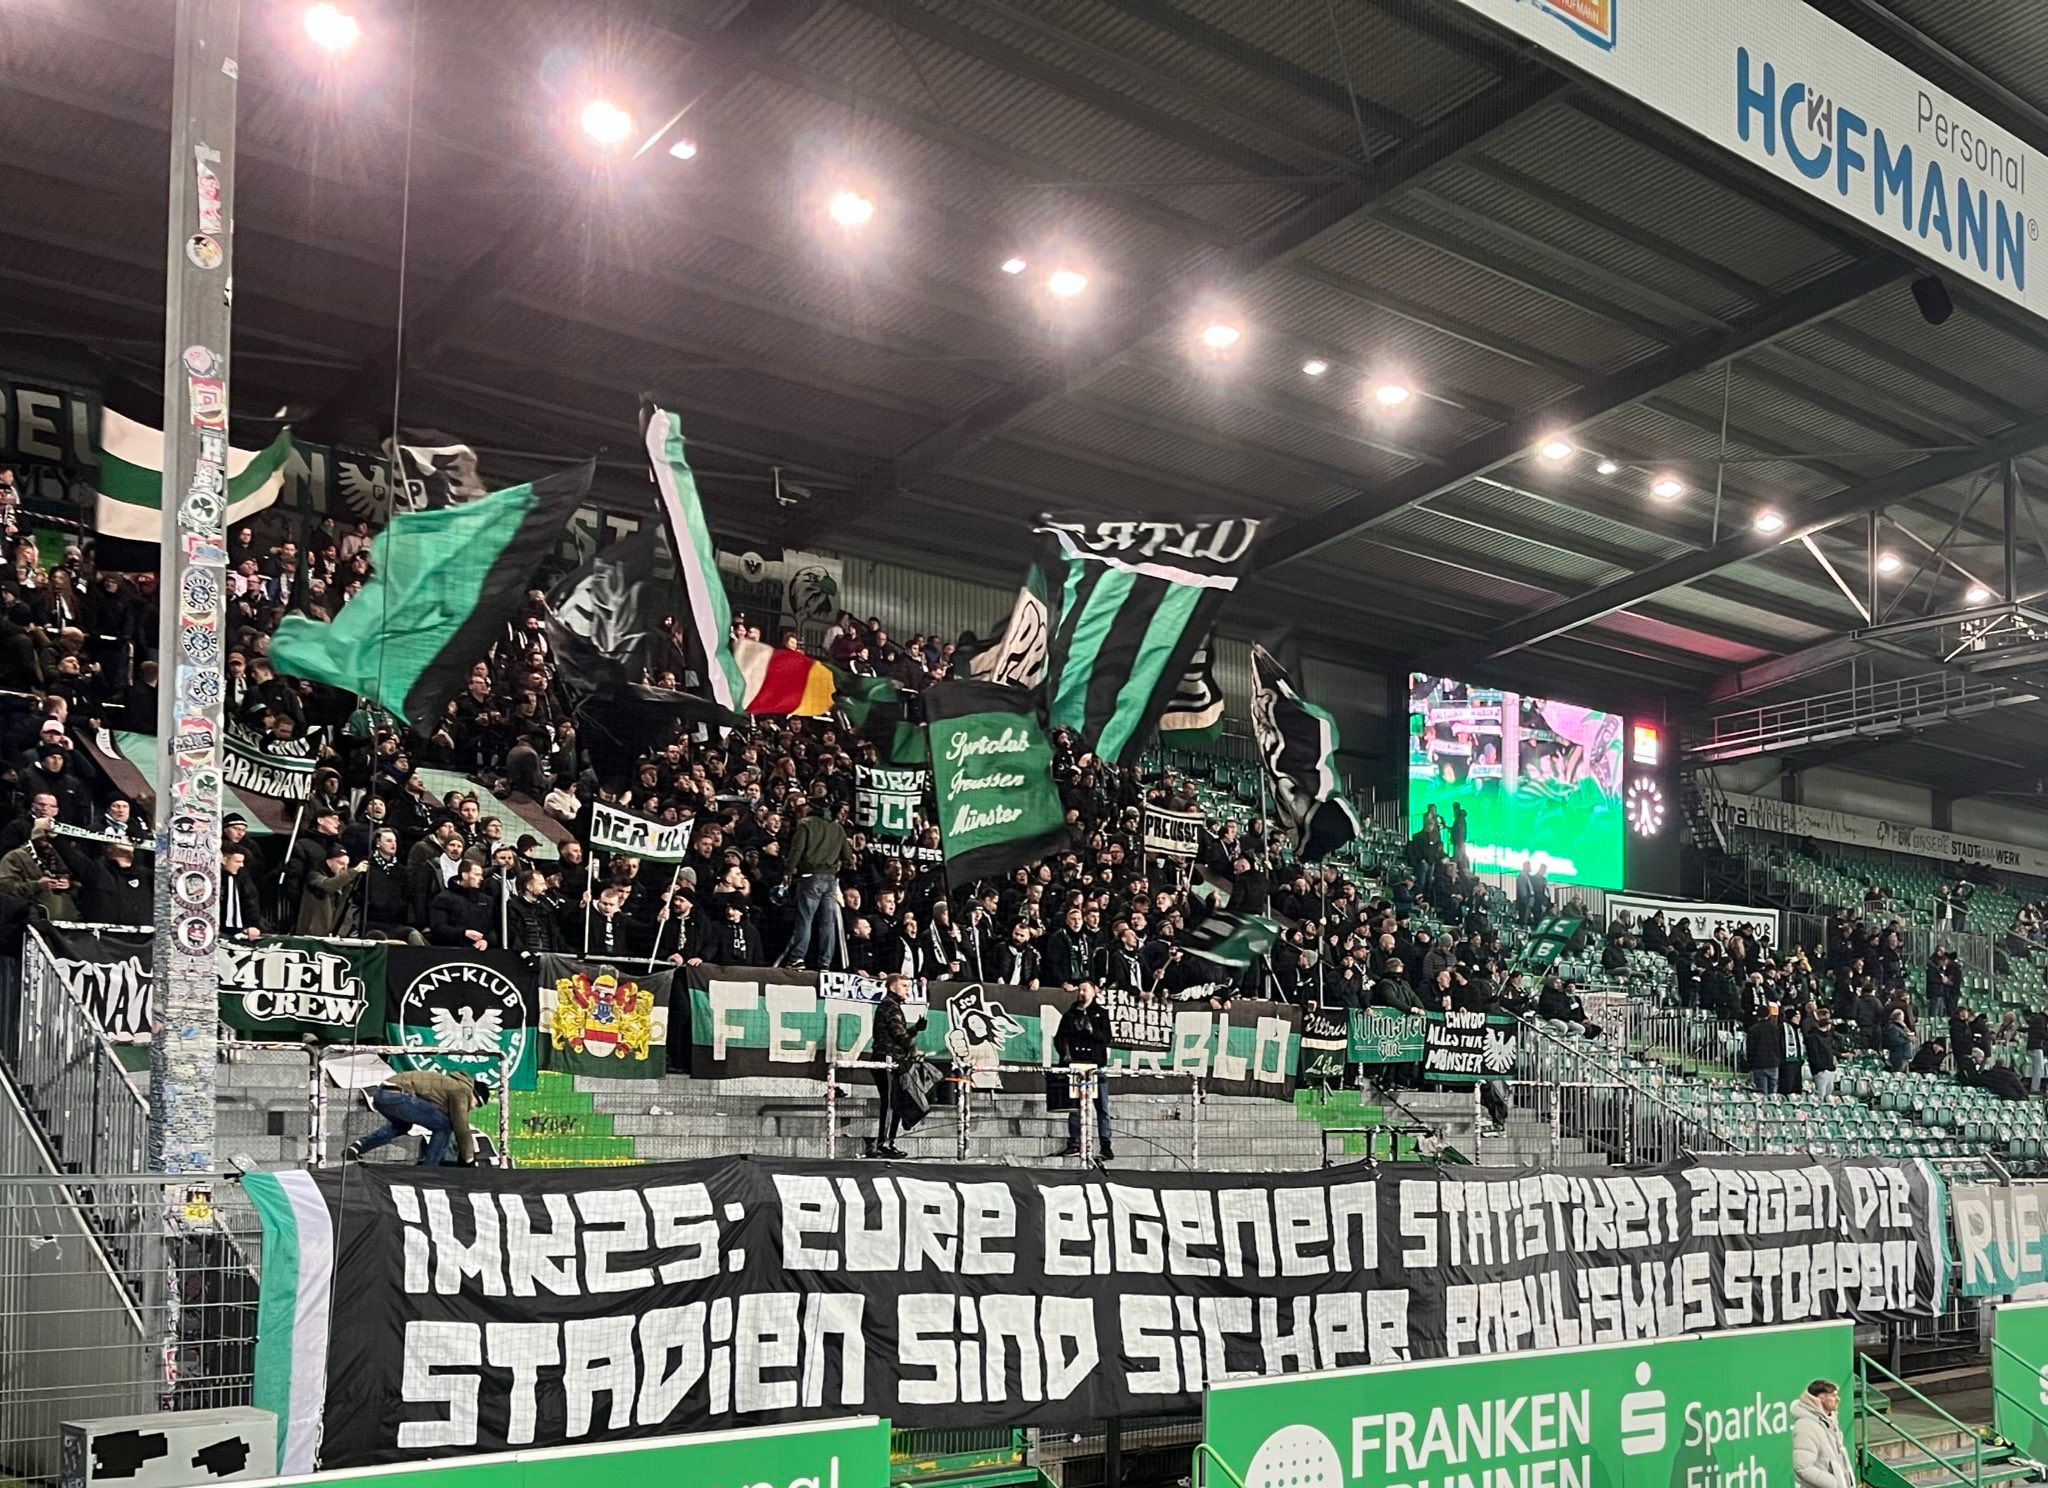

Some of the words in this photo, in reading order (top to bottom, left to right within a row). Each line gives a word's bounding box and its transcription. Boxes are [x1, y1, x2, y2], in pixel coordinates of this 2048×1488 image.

[1918, 90, 2025, 195] Personal
[948, 803, 1022, 837] Münster
[246, 990, 362, 1023] CREW
[408, 966, 518, 1008] FAN-KLUB
[1425, 1049, 1484, 1074] MÜNSTER
[772, 1174, 1017, 1275] EURE
[1038, 1181, 1379, 1278] EIGENEN
[1400, 1174, 1680, 1268] STATISTIKEN
[1844, 1166, 1913, 1230] DIE
[1957, 1194, 2048, 1284] RUE
[397, 1292, 866, 1448] STADIEN
[898, 1293, 1100, 1405] SIND
[1119, 1289, 1412, 1395] SICHER
[1723, 1240, 1918, 1326] STOPPEN!
[1351, 1389, 1591, 1479] FRANKEN
